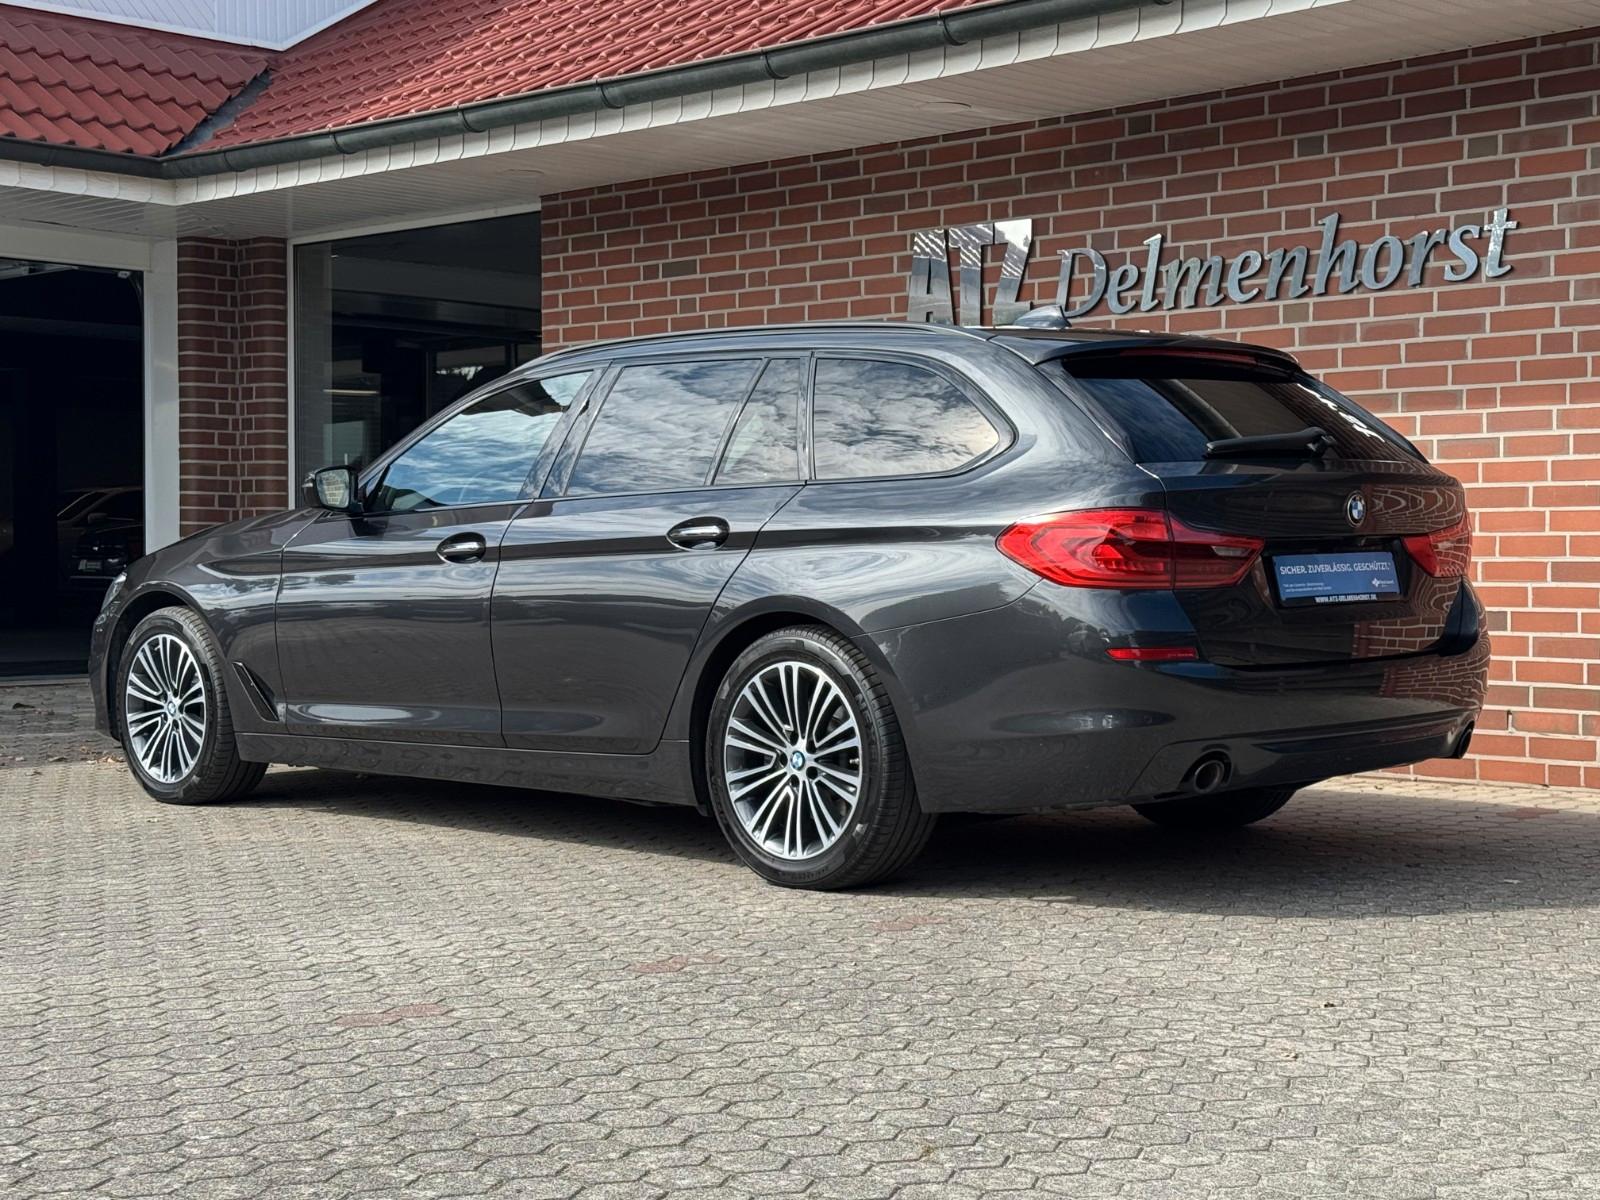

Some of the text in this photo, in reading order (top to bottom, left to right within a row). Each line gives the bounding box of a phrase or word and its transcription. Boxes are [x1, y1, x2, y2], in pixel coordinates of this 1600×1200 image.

[907, 207, 1520, 326] ATZ Delmenhorst
[1280, 565, 1307, 575] SICHER.
[1308, 562, 1353, 574] ZUVERLÄSSIG.
